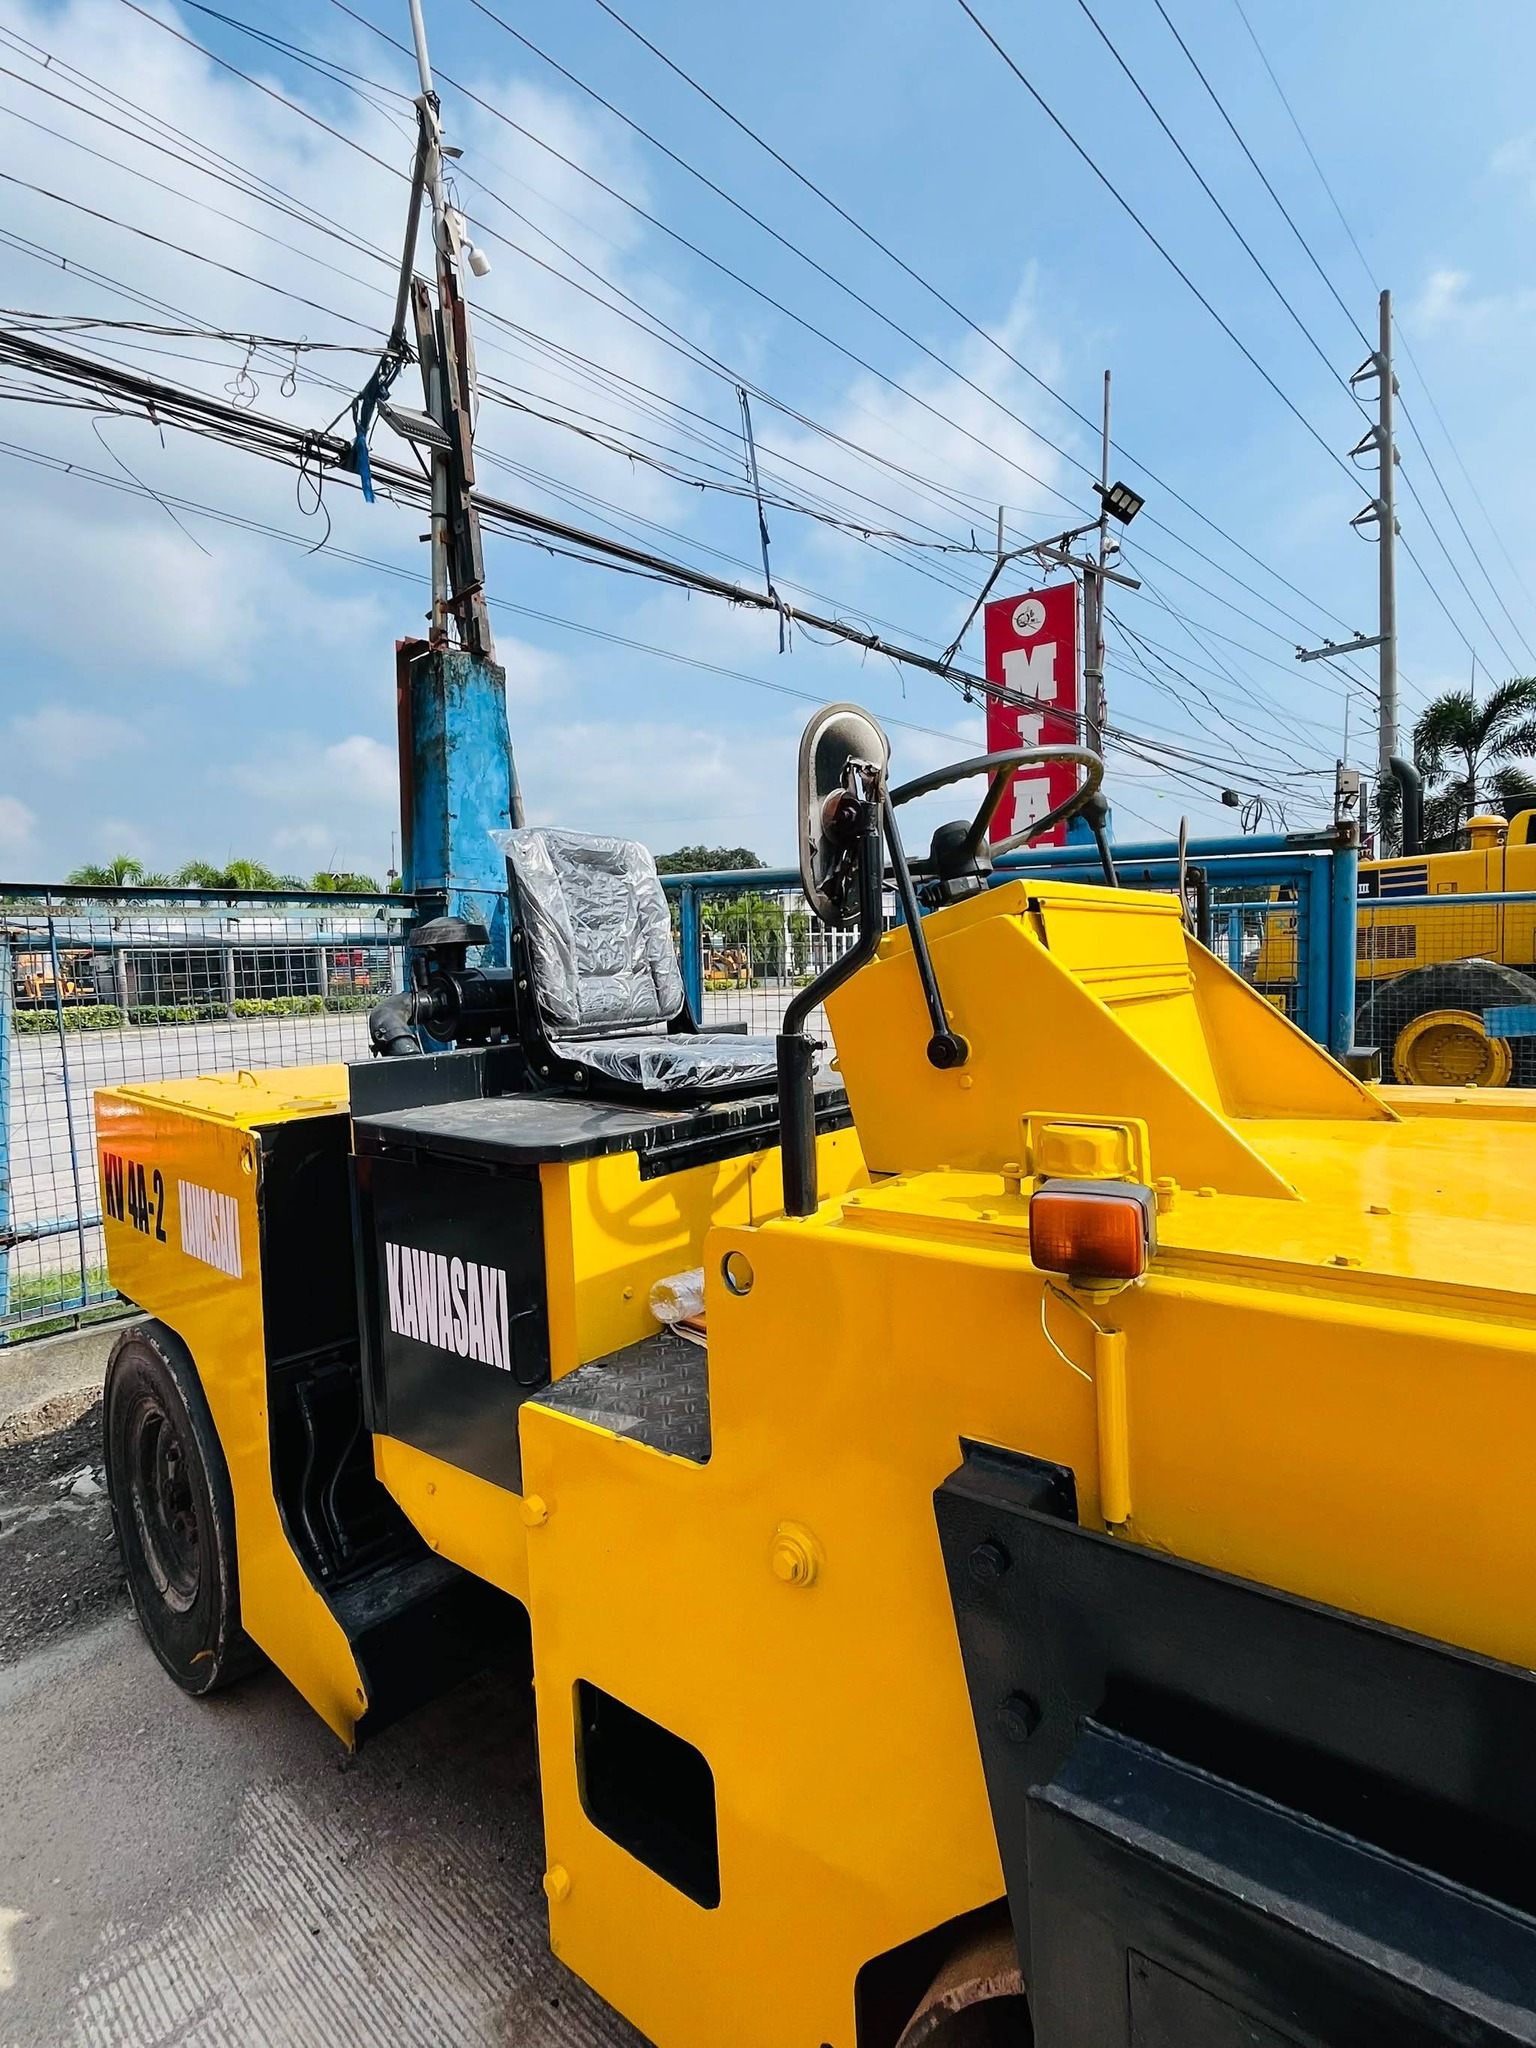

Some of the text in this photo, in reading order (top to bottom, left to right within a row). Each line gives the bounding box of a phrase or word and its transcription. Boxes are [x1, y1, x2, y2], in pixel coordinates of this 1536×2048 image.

[1001, 641, 1058, 850] MIA
[103, 1151, 167, 1244] KV 4A-2
[178, 1178, 242, 1280] KAWASAKI
[385, 1241, 511, 1372] KAWASAKI
